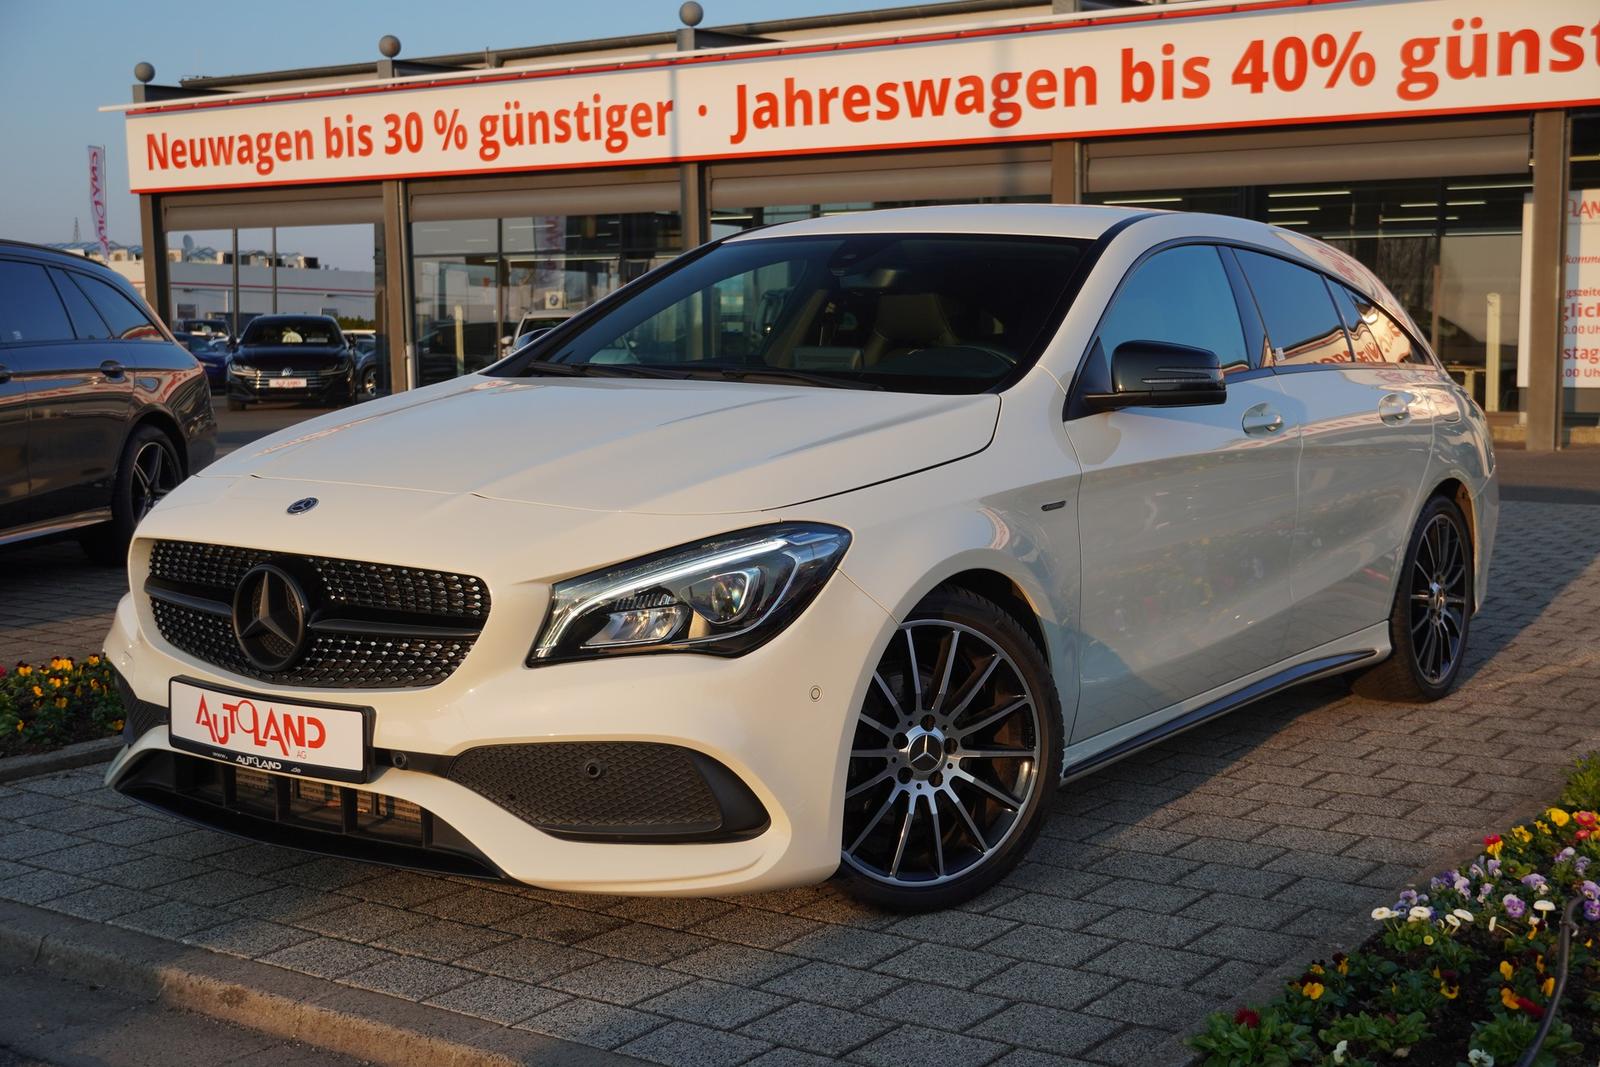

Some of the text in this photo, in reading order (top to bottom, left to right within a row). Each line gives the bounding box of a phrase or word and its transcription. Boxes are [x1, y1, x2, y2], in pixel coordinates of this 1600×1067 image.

[146, 129, 314, 176] Neuwagen
[324, 113, 374, 161] bis
[384, 112, 424, 155] 30
[434, 109, 468, 151] %
[479, 94, 673, 162] günstiger
[730, 66, 1098, 144] Jahreswagen
[1121, 43, 1211, 104] bis
[1232, 31, 1377, 95] 40%
[1562, 346, 1600, 364] stag
[195, 693, 327, 756] AUTOLAND
